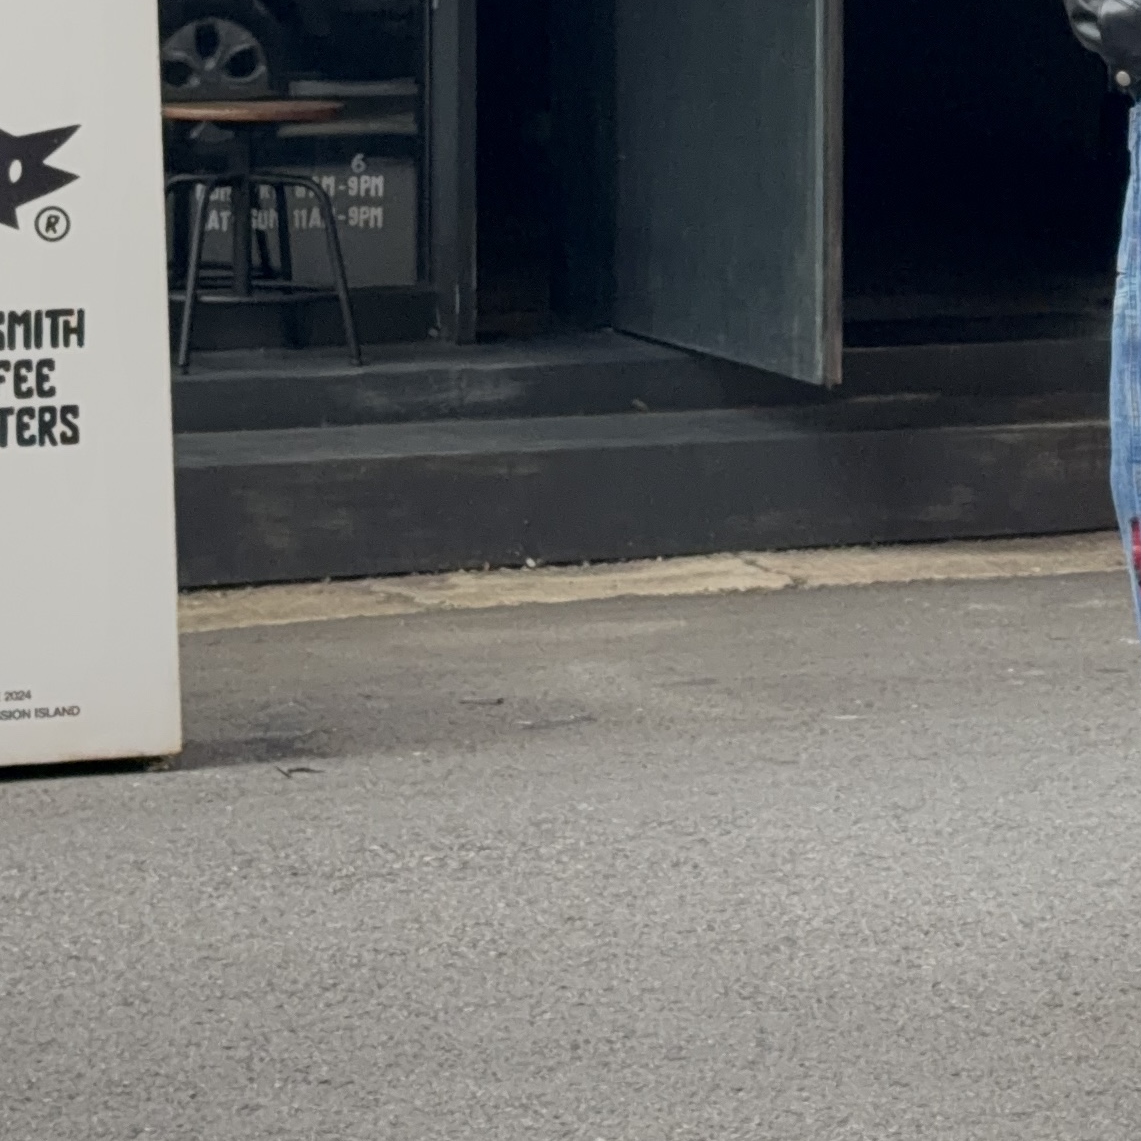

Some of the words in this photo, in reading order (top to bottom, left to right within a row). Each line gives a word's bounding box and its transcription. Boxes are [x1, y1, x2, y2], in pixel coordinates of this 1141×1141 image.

[0, 307, 85, 350] MITH
[4, 690, 32, 701] 2024
[0, 709, 31, 721] SION
[34, 706, 81, 719] ISLAND
